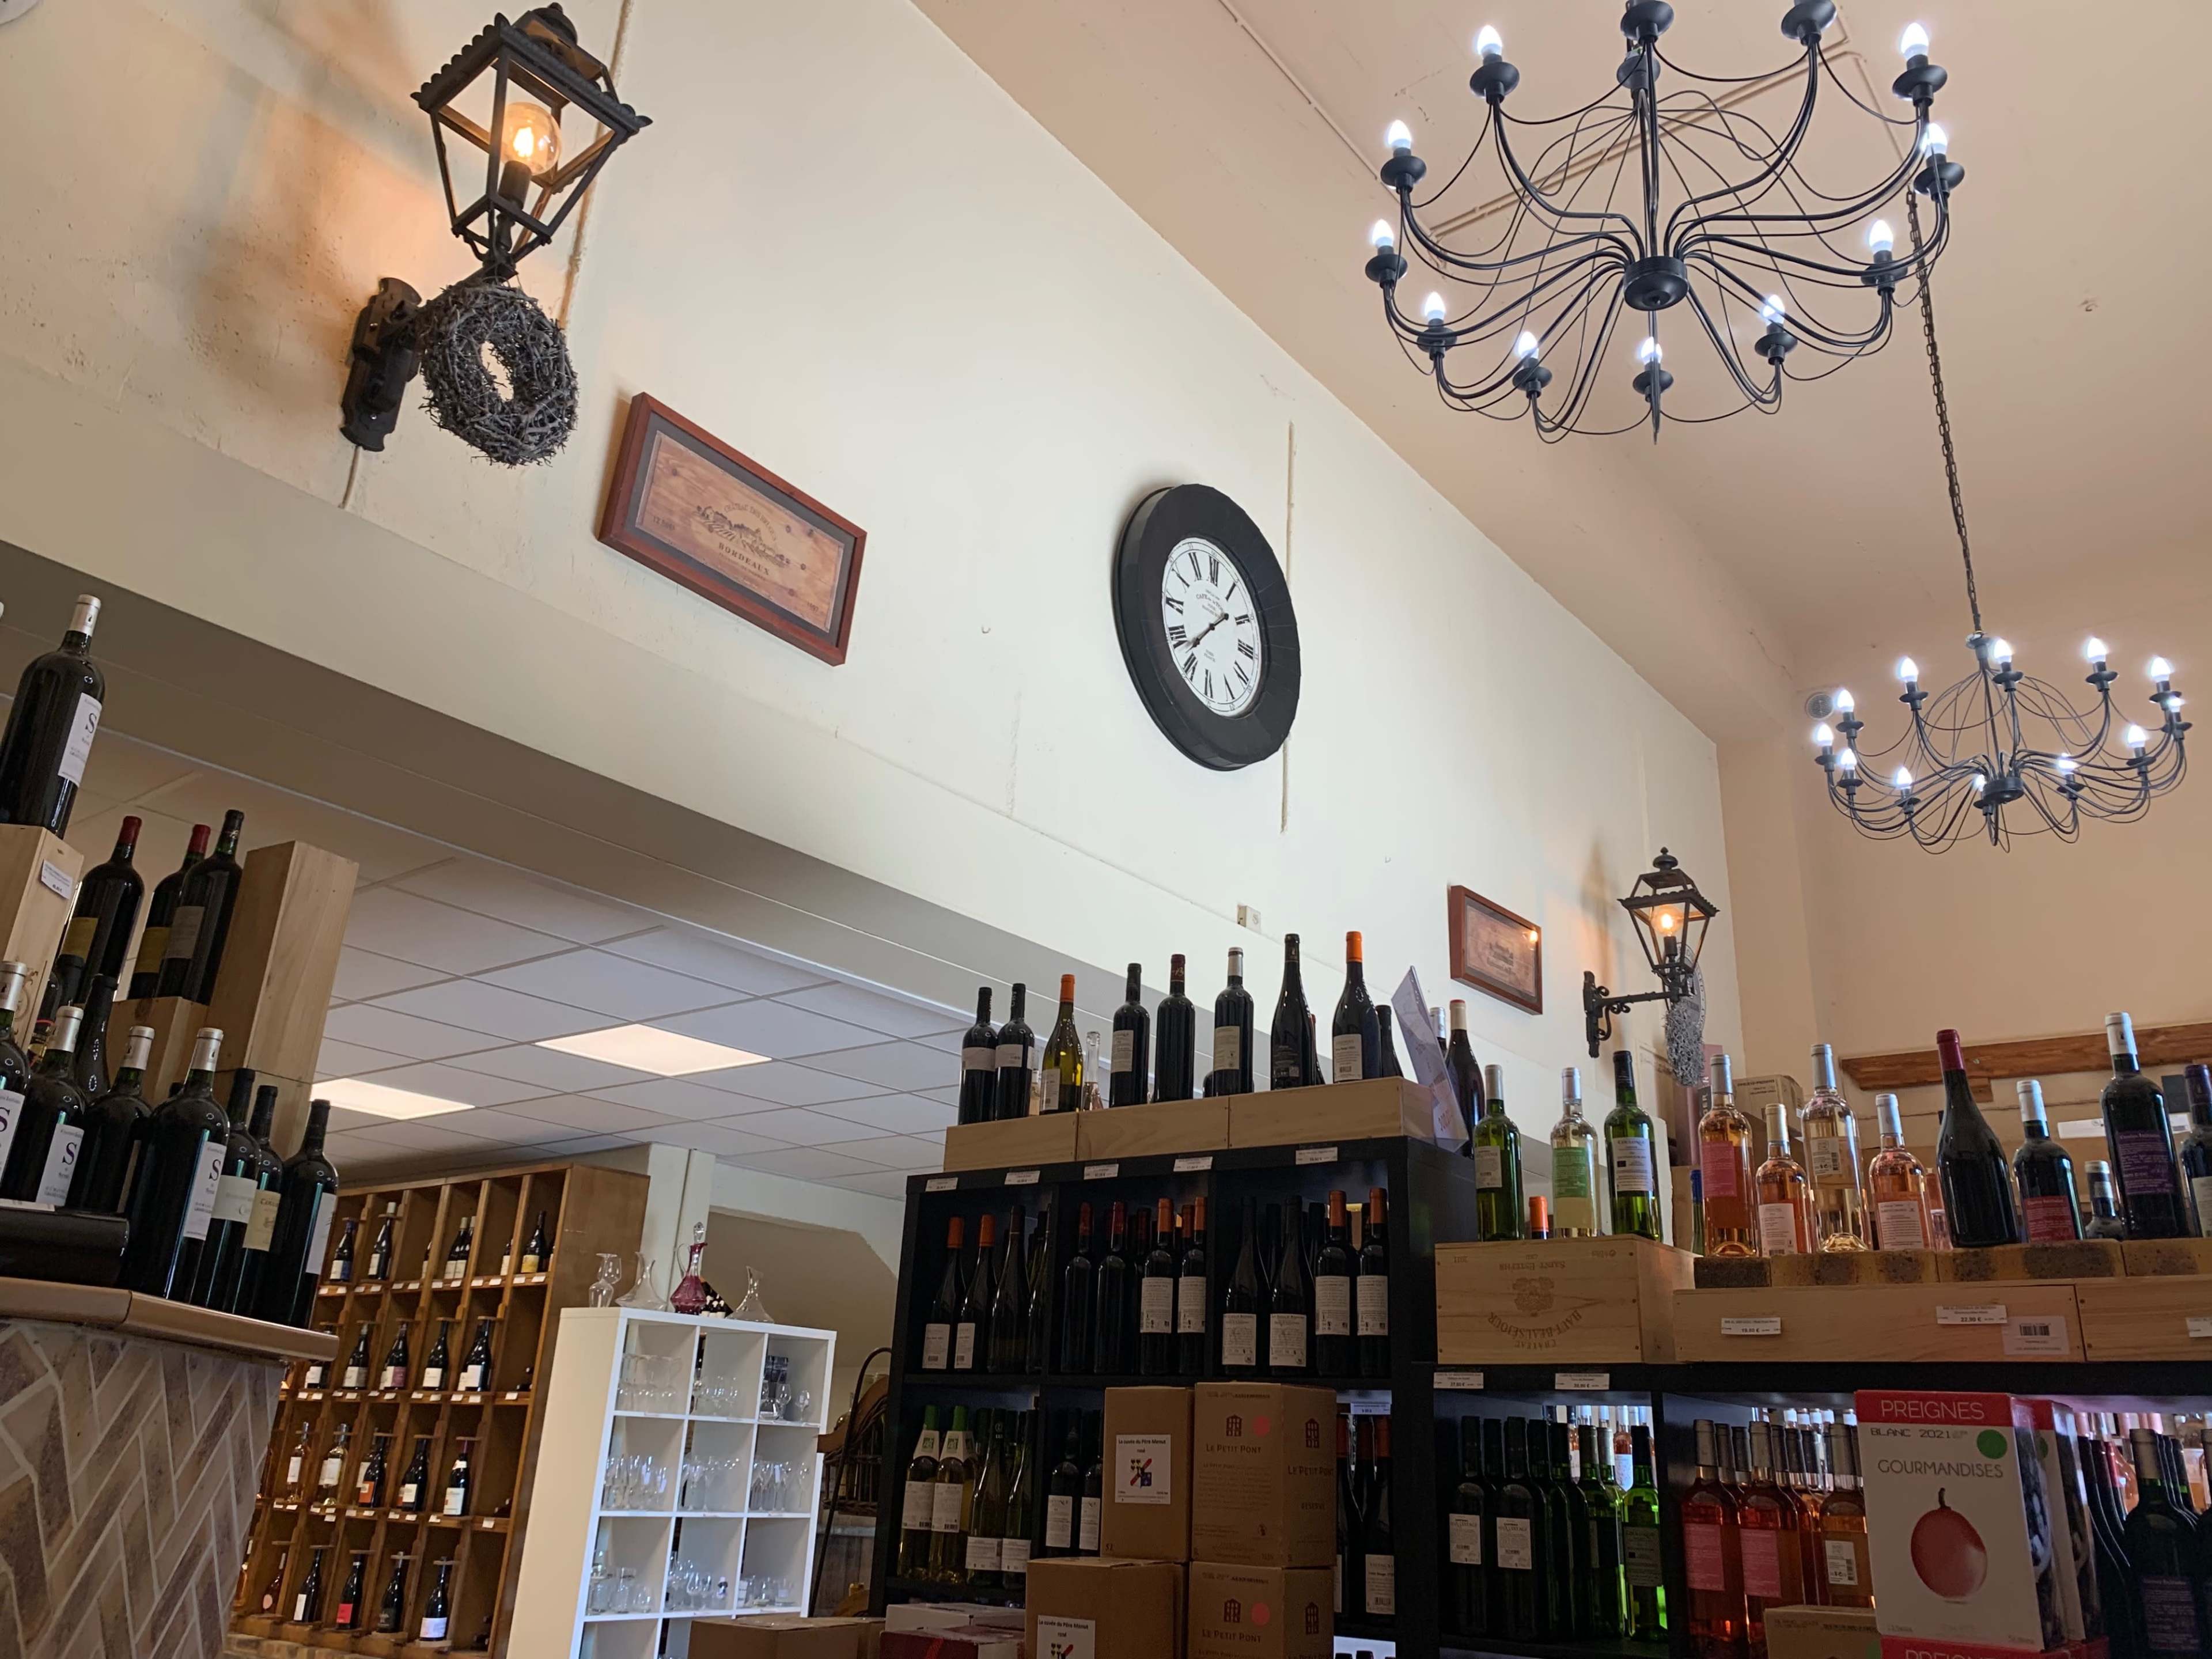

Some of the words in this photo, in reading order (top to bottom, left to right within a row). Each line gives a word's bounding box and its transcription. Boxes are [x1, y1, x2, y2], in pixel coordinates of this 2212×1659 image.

[719, 542, 770, 575] BORDEAUX
[1171, 561, 1191, 594] X
[85, 713, 97, 734] S
[62, 1142, 77, 1165] S
[209, 1159, 221, 1181] S
[1880, 1399, 1984, 1421] PREIGNES
[1870, 1427, 1911, 1437] BLANC
[1919, 1429, 1950, 1439] 2021
[1206, 1444, 1214, 1452] LE
[1216, 1444, 1238, 1453] PETIT
[1240, 1444, 1262, 1454] PONT
[1298, 1465, 1317, 1476] PETIT
[1877, 1459, 2003, 1479] GOURMANDISES
[1202, 1628, 1212, 1638] LE
[1214, 1629, 1236, 1641] PETIT
[1238, 1631, 1262, 1643] PONT
